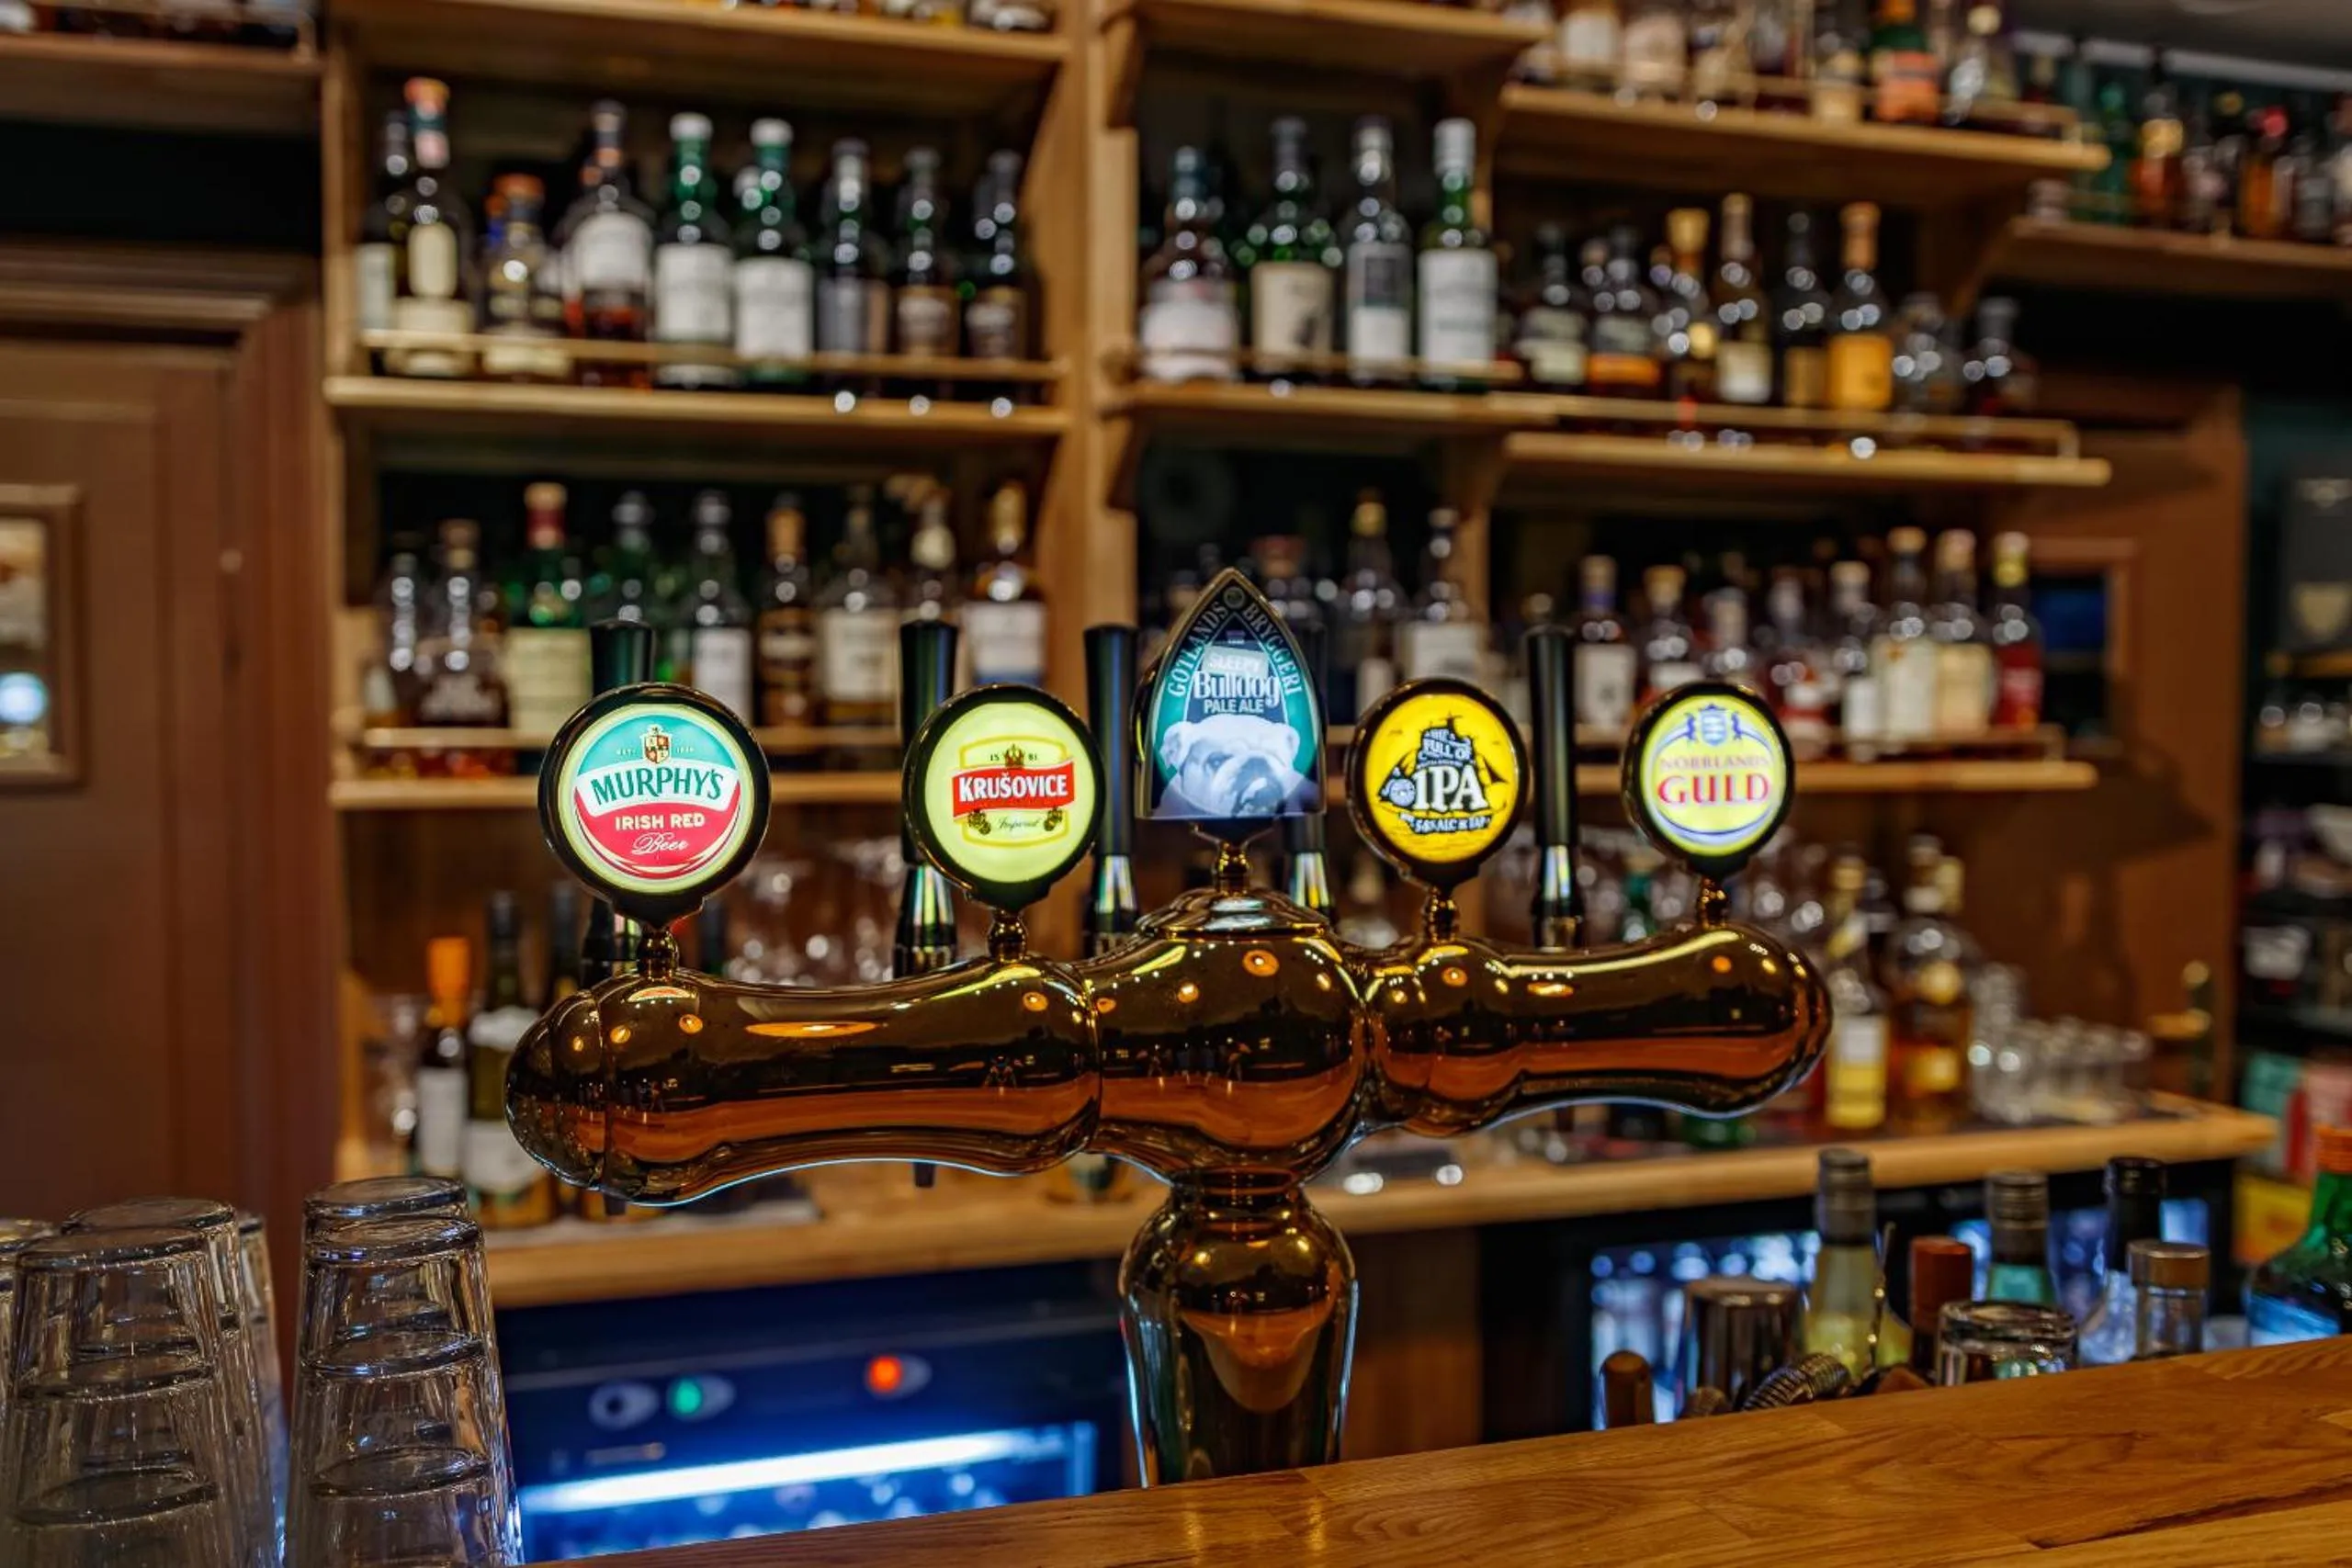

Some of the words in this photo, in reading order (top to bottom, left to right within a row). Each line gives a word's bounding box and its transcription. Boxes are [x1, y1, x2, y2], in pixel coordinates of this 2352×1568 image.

[1167, 601, 1228, 697] GOTLANDS
[1242, 603, 1303, 694] BRYGGERI
[1193, 671, 1281, 708] Bulldog
[1204, 698, 1237, 714] PALE
[1238, 698, 1265, 714] ALE
[1423, 739, 1454, 759] FULL
[591, 766, 724, 806] MURPHY'S
[958, 772, 1069, 803] KRUŠOVICE
[1411, 764, 1489, 812] IPA
[1657, 773, 1770, 805] GULD
[615, 814, 664, 831] IRISH
[670, 812, 706, 829] RED
[631, 831, 689, 856] Beer
